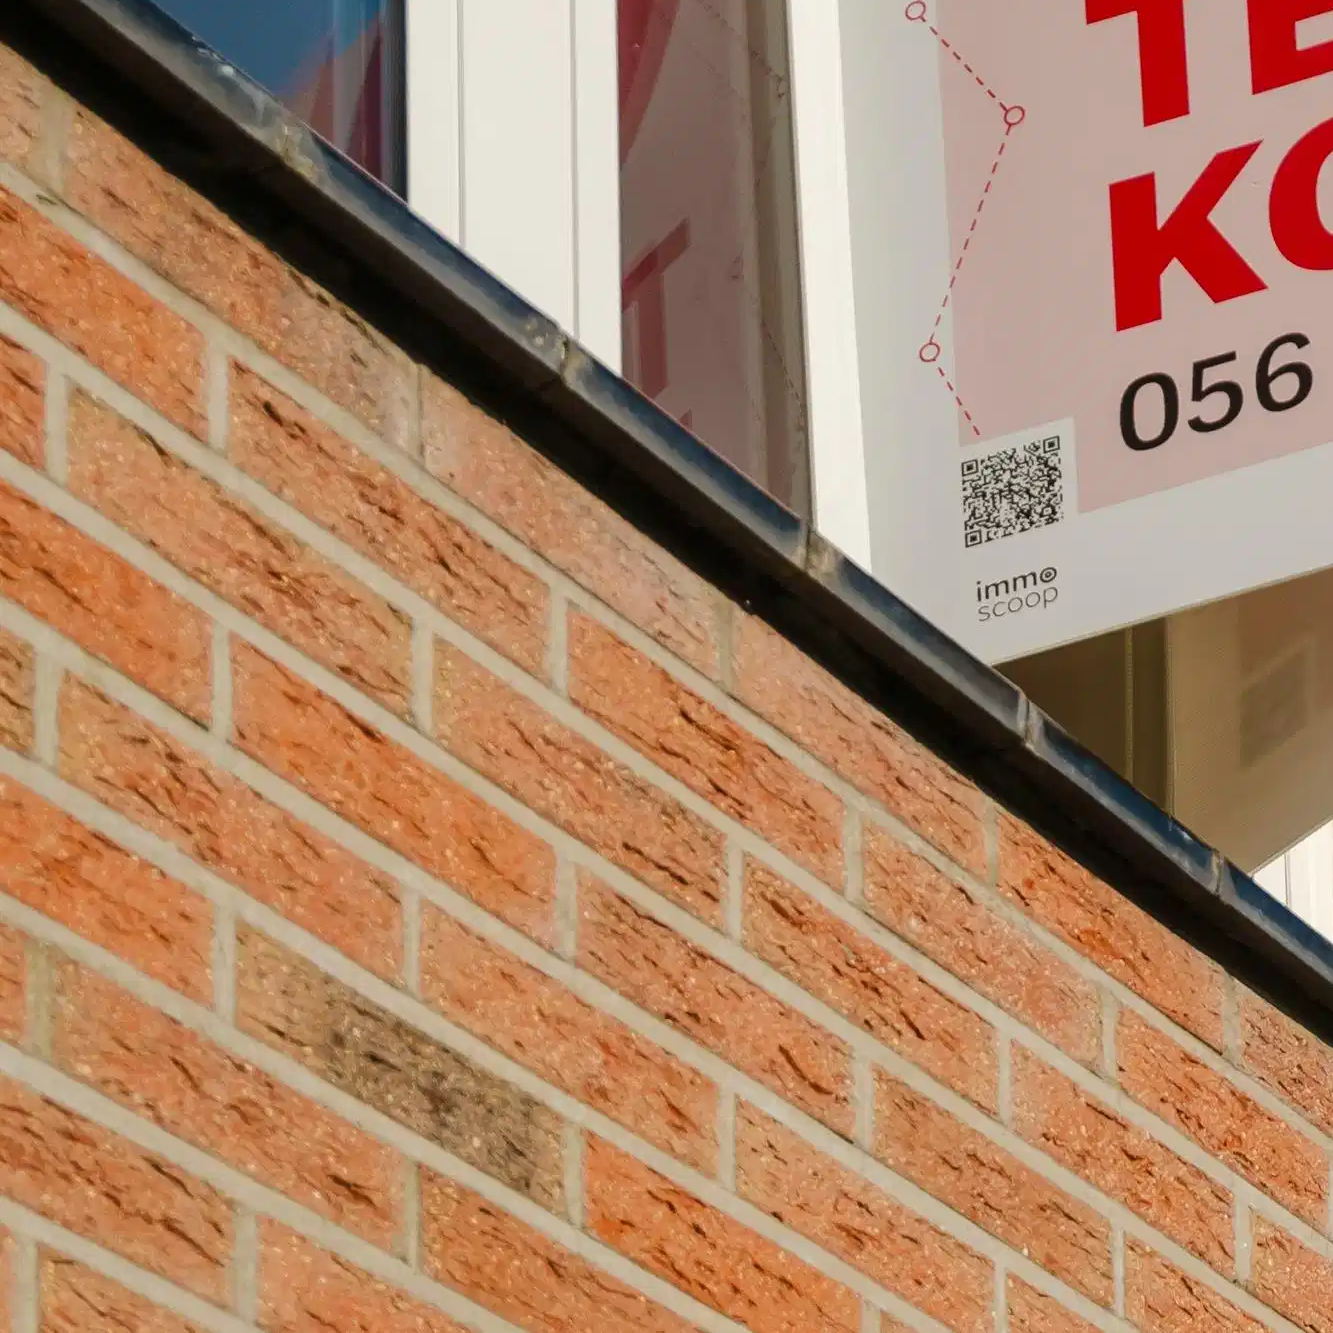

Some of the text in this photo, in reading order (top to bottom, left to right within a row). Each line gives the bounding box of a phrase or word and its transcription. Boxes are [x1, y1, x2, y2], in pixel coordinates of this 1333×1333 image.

[1119, 331, 1314, 452] 056
[976, 566, 1058, 602] immo
[977, 585, 1059, 622] scoop
